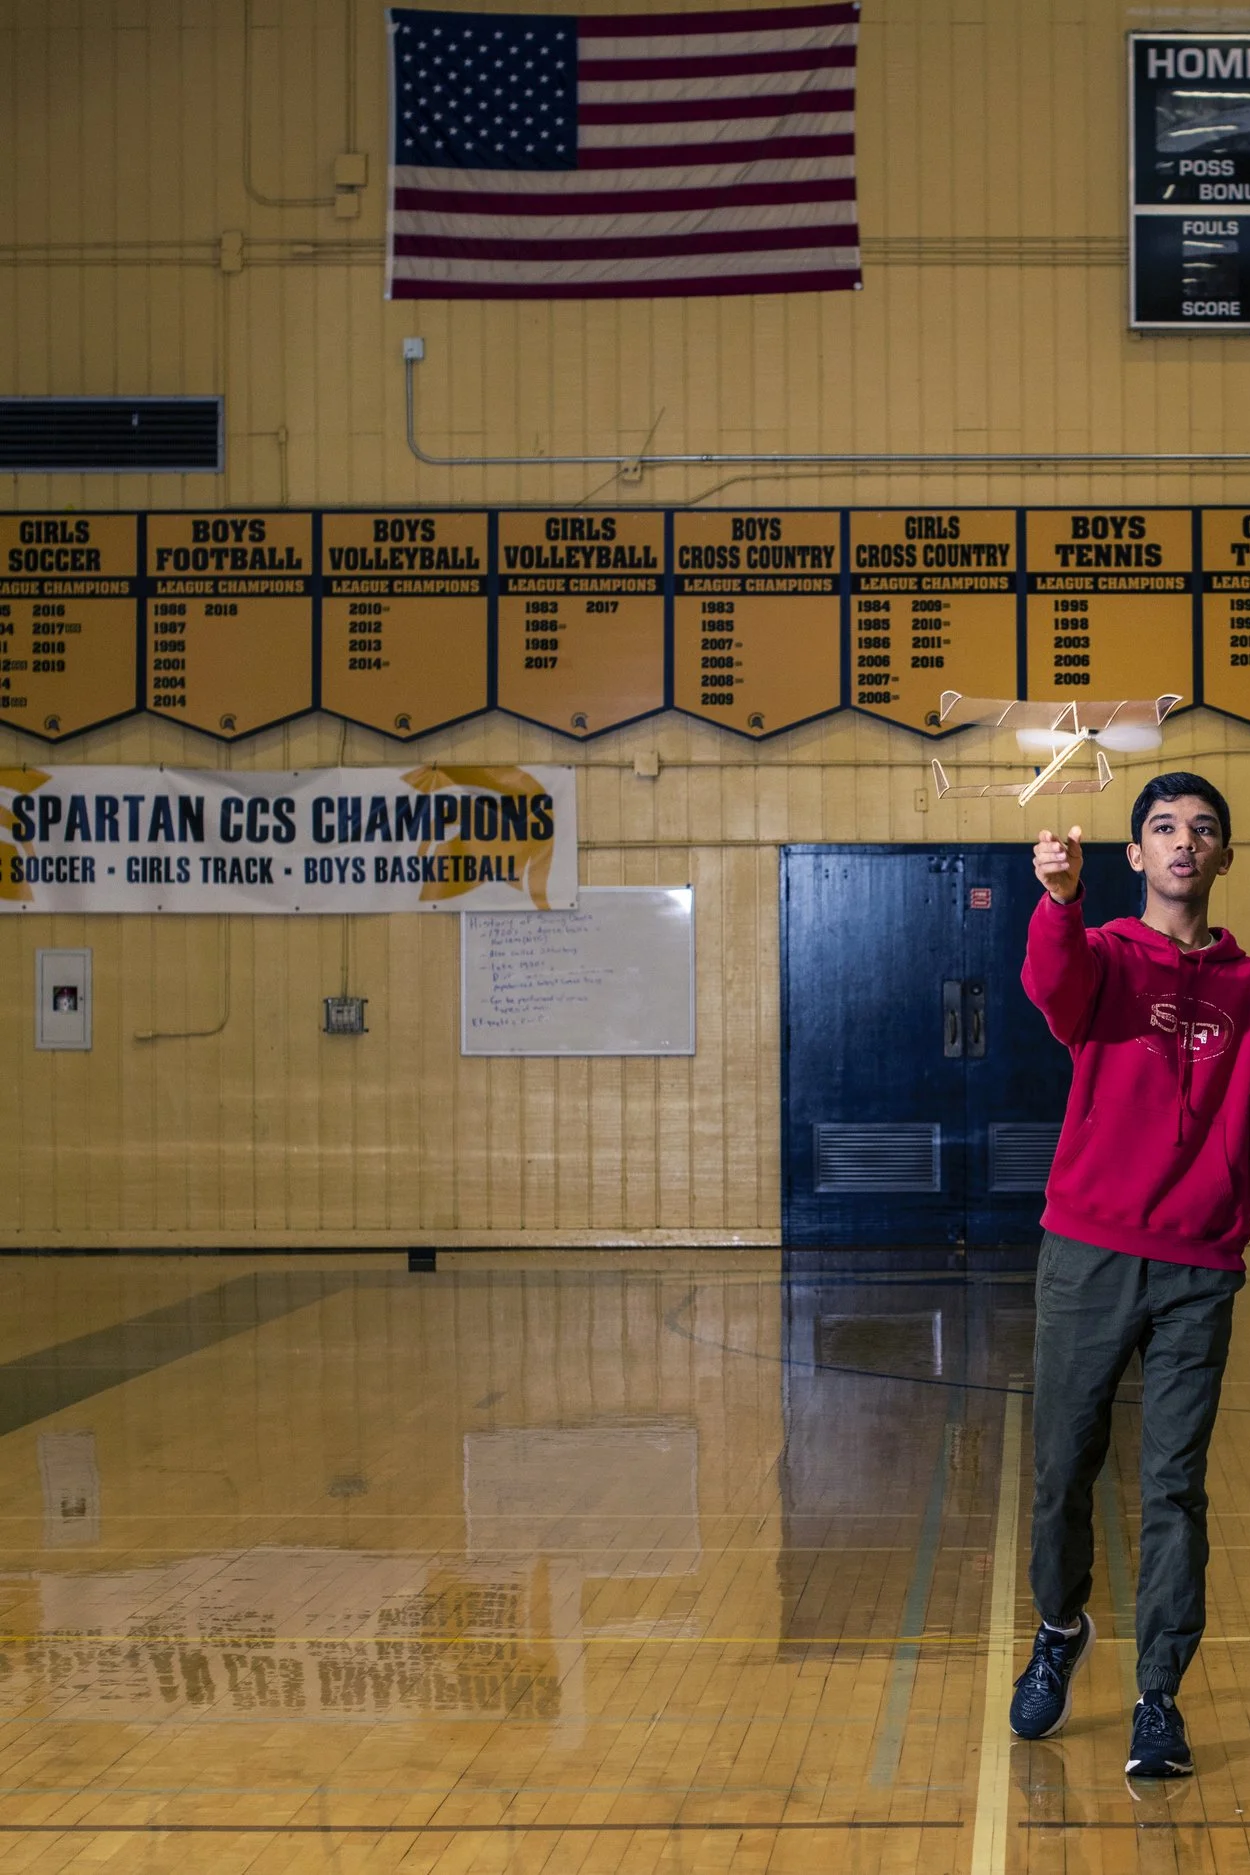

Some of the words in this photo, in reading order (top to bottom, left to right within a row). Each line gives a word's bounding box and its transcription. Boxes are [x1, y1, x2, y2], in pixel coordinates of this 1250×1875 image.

[1180, 160, 1234, 175] POSS
[1183, 221, 1238, 235] FOULS
[1183, 302, 1240, 315] SCORE
[20, 520, 89, 544] GIRLS
[192, 519, 265, 543] BOYS
[374, 519, 435, 542] BOYS
[546, 518, 616, 541] GIRLS
[732, 518, 781, 541] BOYS
[905, 516, 960, 539] GIRLS
[1072, 516, 1145, 539] BOYS
[9, 548, 100, 572] SOCCER
[157, 547, 302, 571] FOOTBALL
[329, 547, 479, 570] VOLLEYBALL
[504, 546, 657, 569] VOLLEYBALL
[679, 546, 740, 569] CROSS
[747, 545, 834, 569] COUNTRY
[856, 544, 916, 568] CROSS
[923, 544, 1009, 567] COUNTRY
[1055, 544, 1162, 567] TENNIS
[44, 581, 129, 594] CHAMPIONS
[157, 581, 213, 593] LEAGUE
[218, 580, 304, 593] CHAMPIONS
[333, 580, 388, 593] LEAGUE
[394, 580, 479, 592] CHAMPIONS
[509, 579, 565, 591] LEAGUE
[570, 579, 656, 591] CHAMPIONS
[684, 579, 741, 591] LEAGUE
[746, 579, 832, 591] CHAMPIONS
[861, 578, 917, 590] LEAGUE
[922, 577, 1008, 589] CHAMPIONS
[1037, 577, 1093, 589] LEAGUE
[1098, 577, 1184, 589] CHAMPIONS
[205, 604, 237, 616] 2018
[526, 602, 558, 613] 1983
[586, 601, 618, 613] 2017
[702, 602, 734, 613] 1983
[858, 600, 890, 612] 1984
[1055, 600, 1088, 612] 1995
[155, 622, 186, 634] 1987
[349, 621, 382, 633] 2012
[702, 620, 734, 632] 1985
[858, 619, 890, 630] 1985
[1055, 618, 1088, 630] 1998
[154, 640, 185, 652] 1995
[349, 639, 381, 651] 2013
[858, 637, 890, 649] 1986
[1054, 636, 1090, 648] 2003
[33, 660, 65, 672] 2019
[154, 659, 185, 670] 2001
[525, 657, 557, 669] 2017
[858, 655, 890, 667] 2006
[911, 656, 944, 668] 2016
[1054, 655, 1090, 666] 2006
[154, 677, 185, 688] 2004
[1055, 673, 1090, 685] 2009
[154, 695, 186, 707] 2014
[702, 693, 733, 705] 2009
[12, 795, 204, 842] SPARTAN
[220, 795, 296, 843] CCS
[313, 795, 554, 843] CHAMPIONS
[10, 856, 95, 883] SOCCER
[126, 856, 190, 883] GIRLS
[200, 855, 273, 884] TRACK
[304, 856, 366, 883] BOYS
[374, 854, 519, 883] BASKETBALL
[1151, 1003, 1220, 1051] SF
